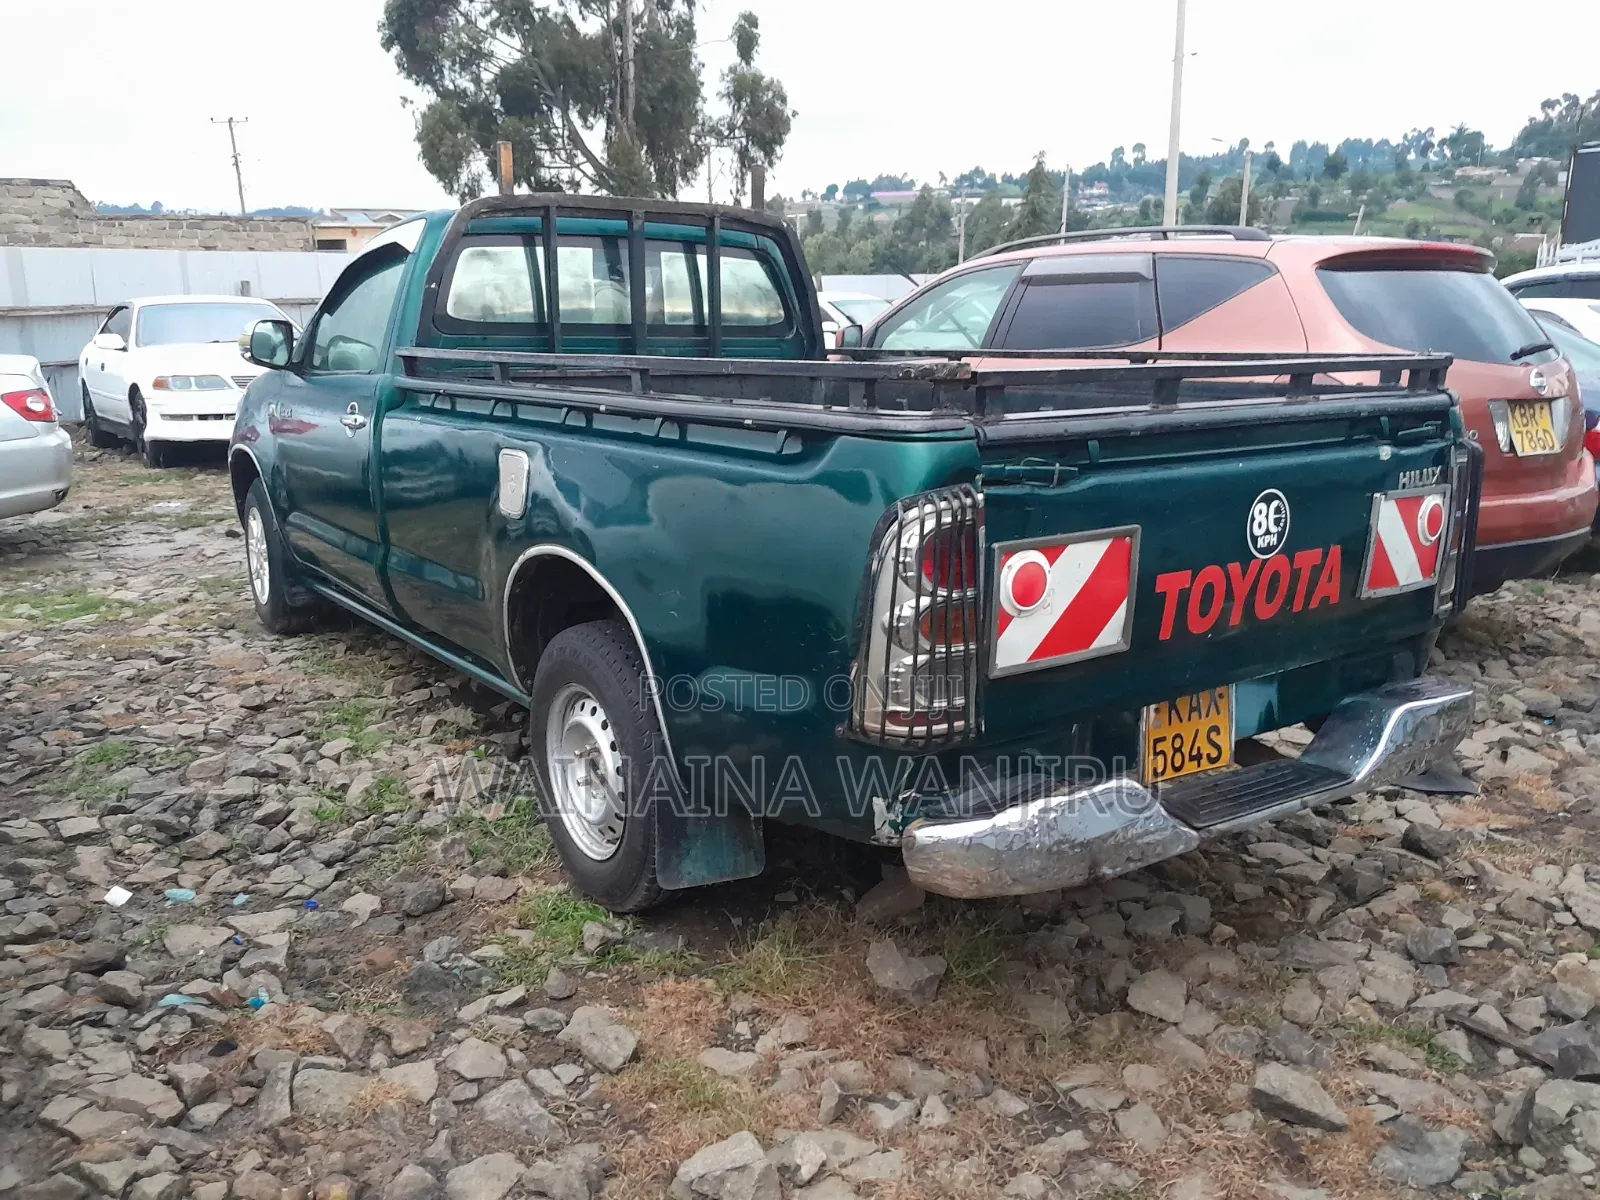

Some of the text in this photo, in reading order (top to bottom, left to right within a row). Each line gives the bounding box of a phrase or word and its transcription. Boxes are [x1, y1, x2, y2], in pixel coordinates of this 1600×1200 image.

[1509, 404, 1539, 428] KBR
[1398, 465, 1442, 490] HILUX
[1252, 499, 1286, 537] 80
[1256, 533, 1278, 549] KPH
[1154, 544, 1342, 641] TOYOTA
[1167, 689, 1221, 727] KAX
[1152, 724, 1223, 778] 584S
